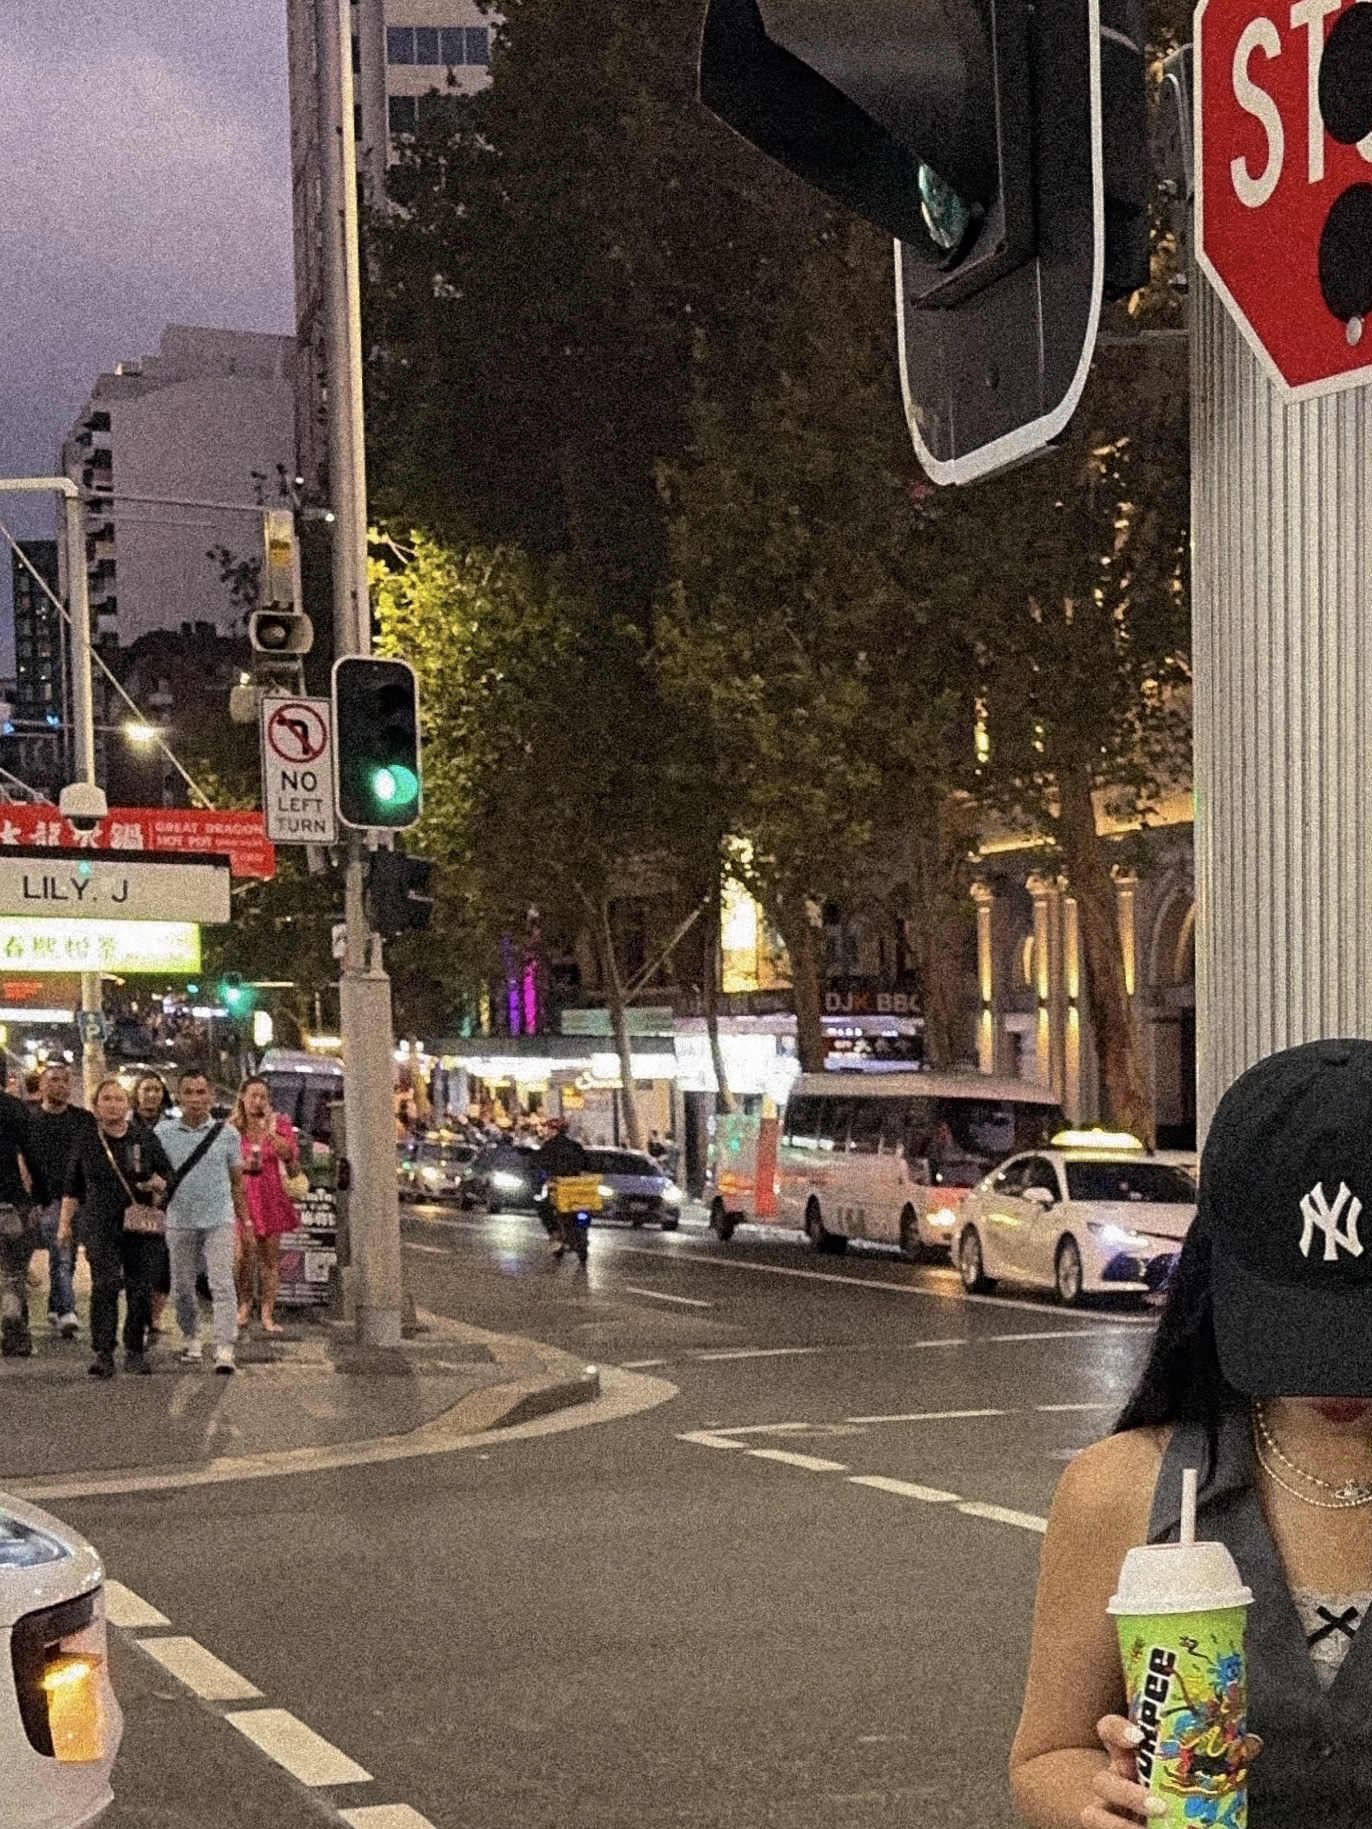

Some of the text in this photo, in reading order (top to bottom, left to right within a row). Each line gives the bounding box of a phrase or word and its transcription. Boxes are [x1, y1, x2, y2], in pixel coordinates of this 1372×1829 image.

[281, 770, 318, 792] NO
[277, 798, 323, 812] LEFT
[154, 820, 199, 833] GREAT
[278, 818, 326, 834] TURN
[111, 876, 129, 903] J
[825, 991, 869, 1012] DJK
[1298, 1180, 1365, 1262] NY
